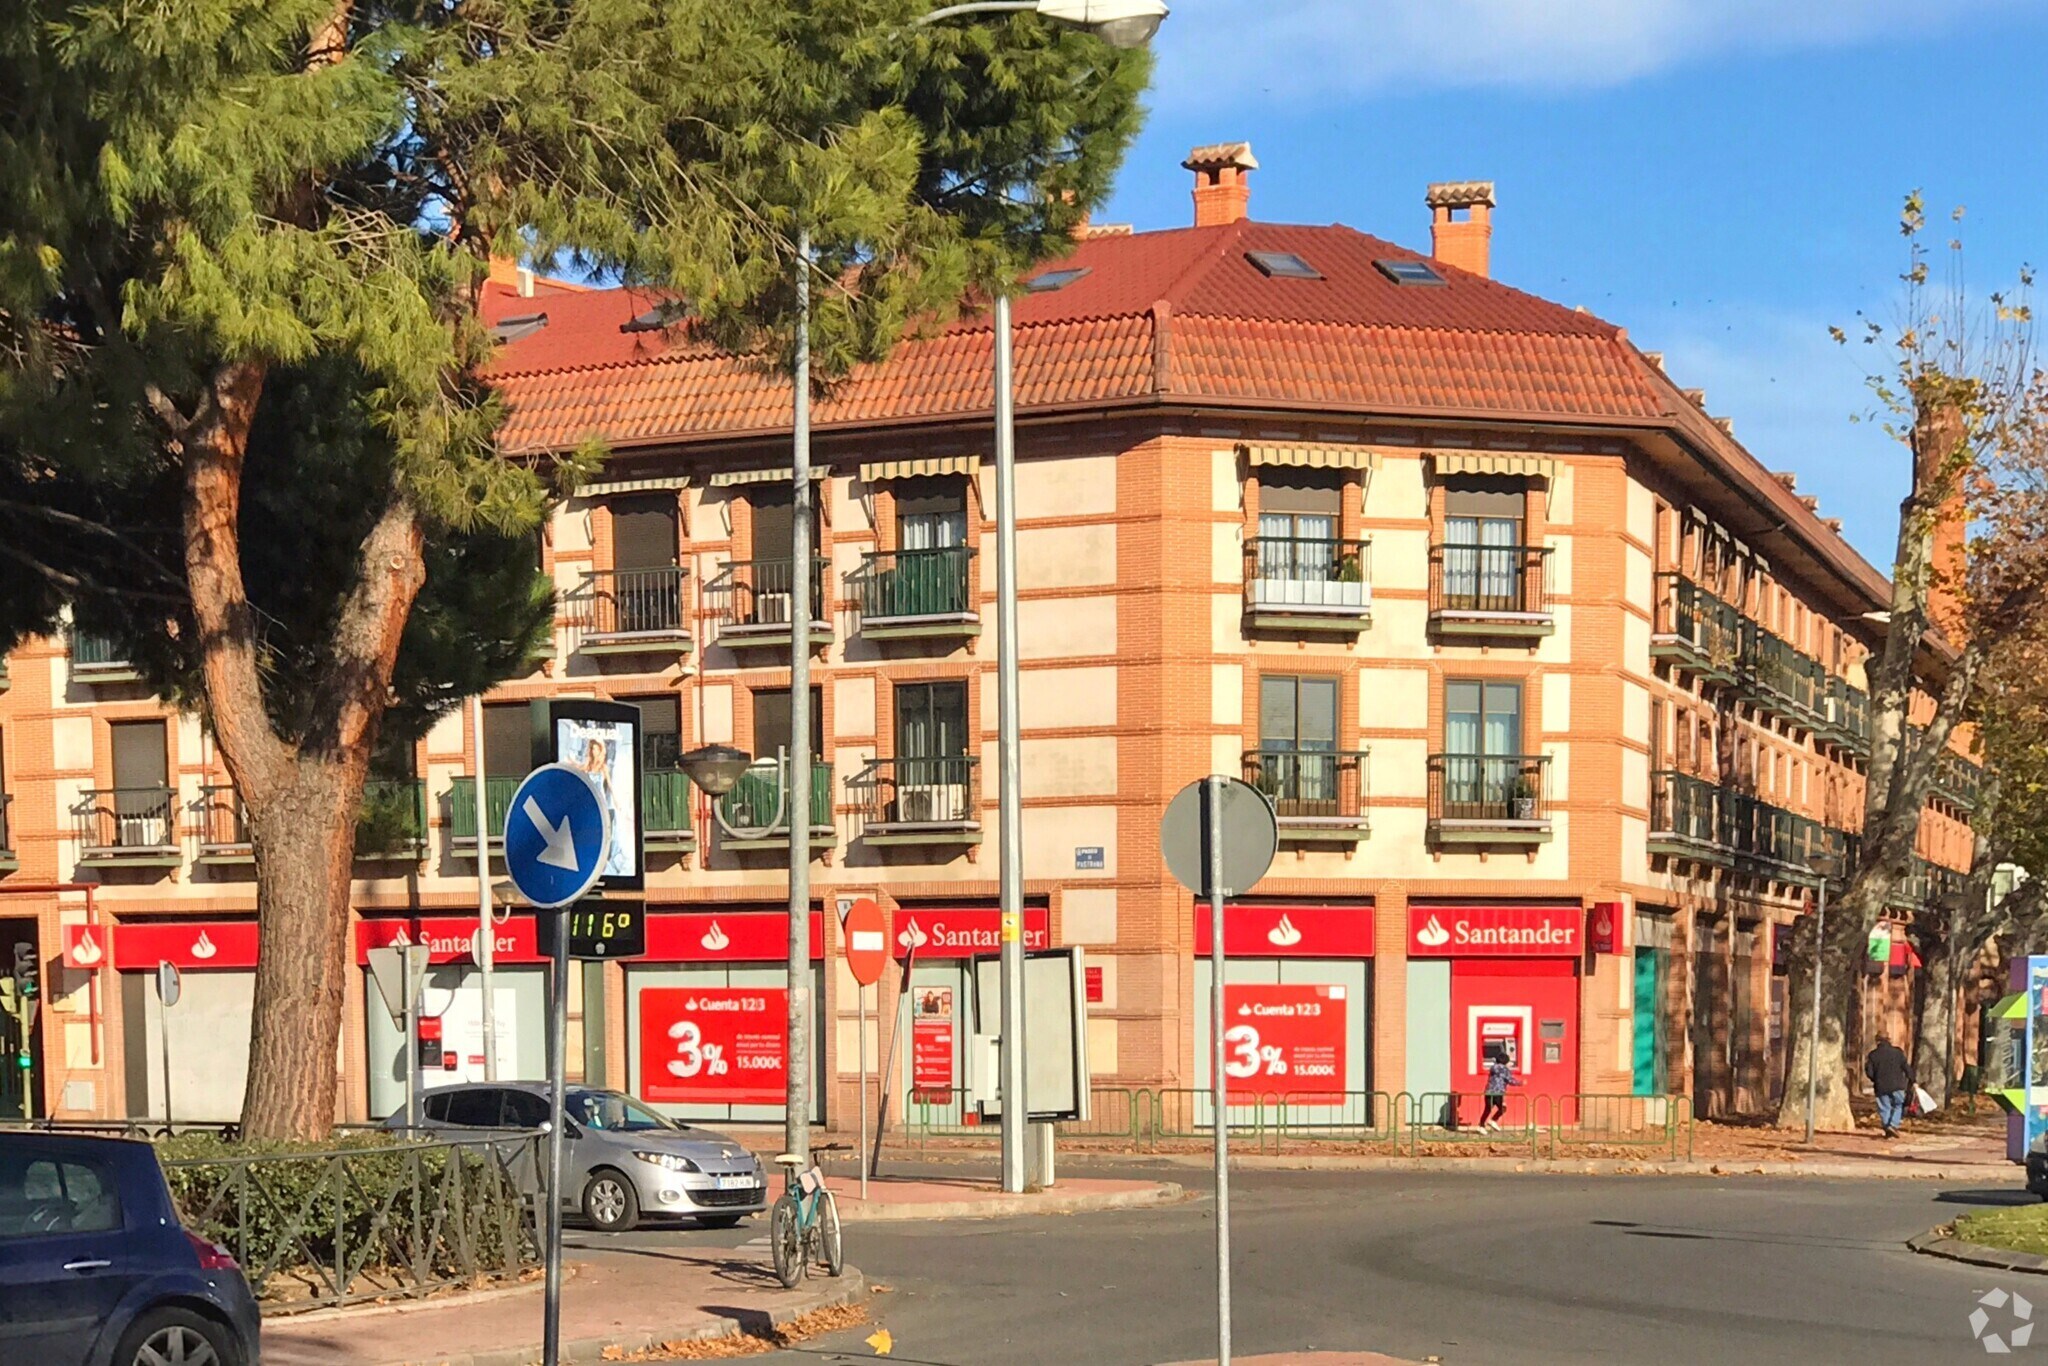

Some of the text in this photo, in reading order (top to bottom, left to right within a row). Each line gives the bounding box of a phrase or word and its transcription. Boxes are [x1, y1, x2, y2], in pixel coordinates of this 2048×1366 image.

[418, 931, 517, 954] Santaer
[931, 922, 1045, 947] Santaer
[1455, 919, 1575, 945] Santander
[699, 997, 740, 1011] Cuenta
[1253, 1002, 1295, 1016] Cuenta
[666, 1020, 728, 1077] 3%
[1225, 1024, 1288, 1077] 3%
[736, 1056, 783, 1069] 15.000€
